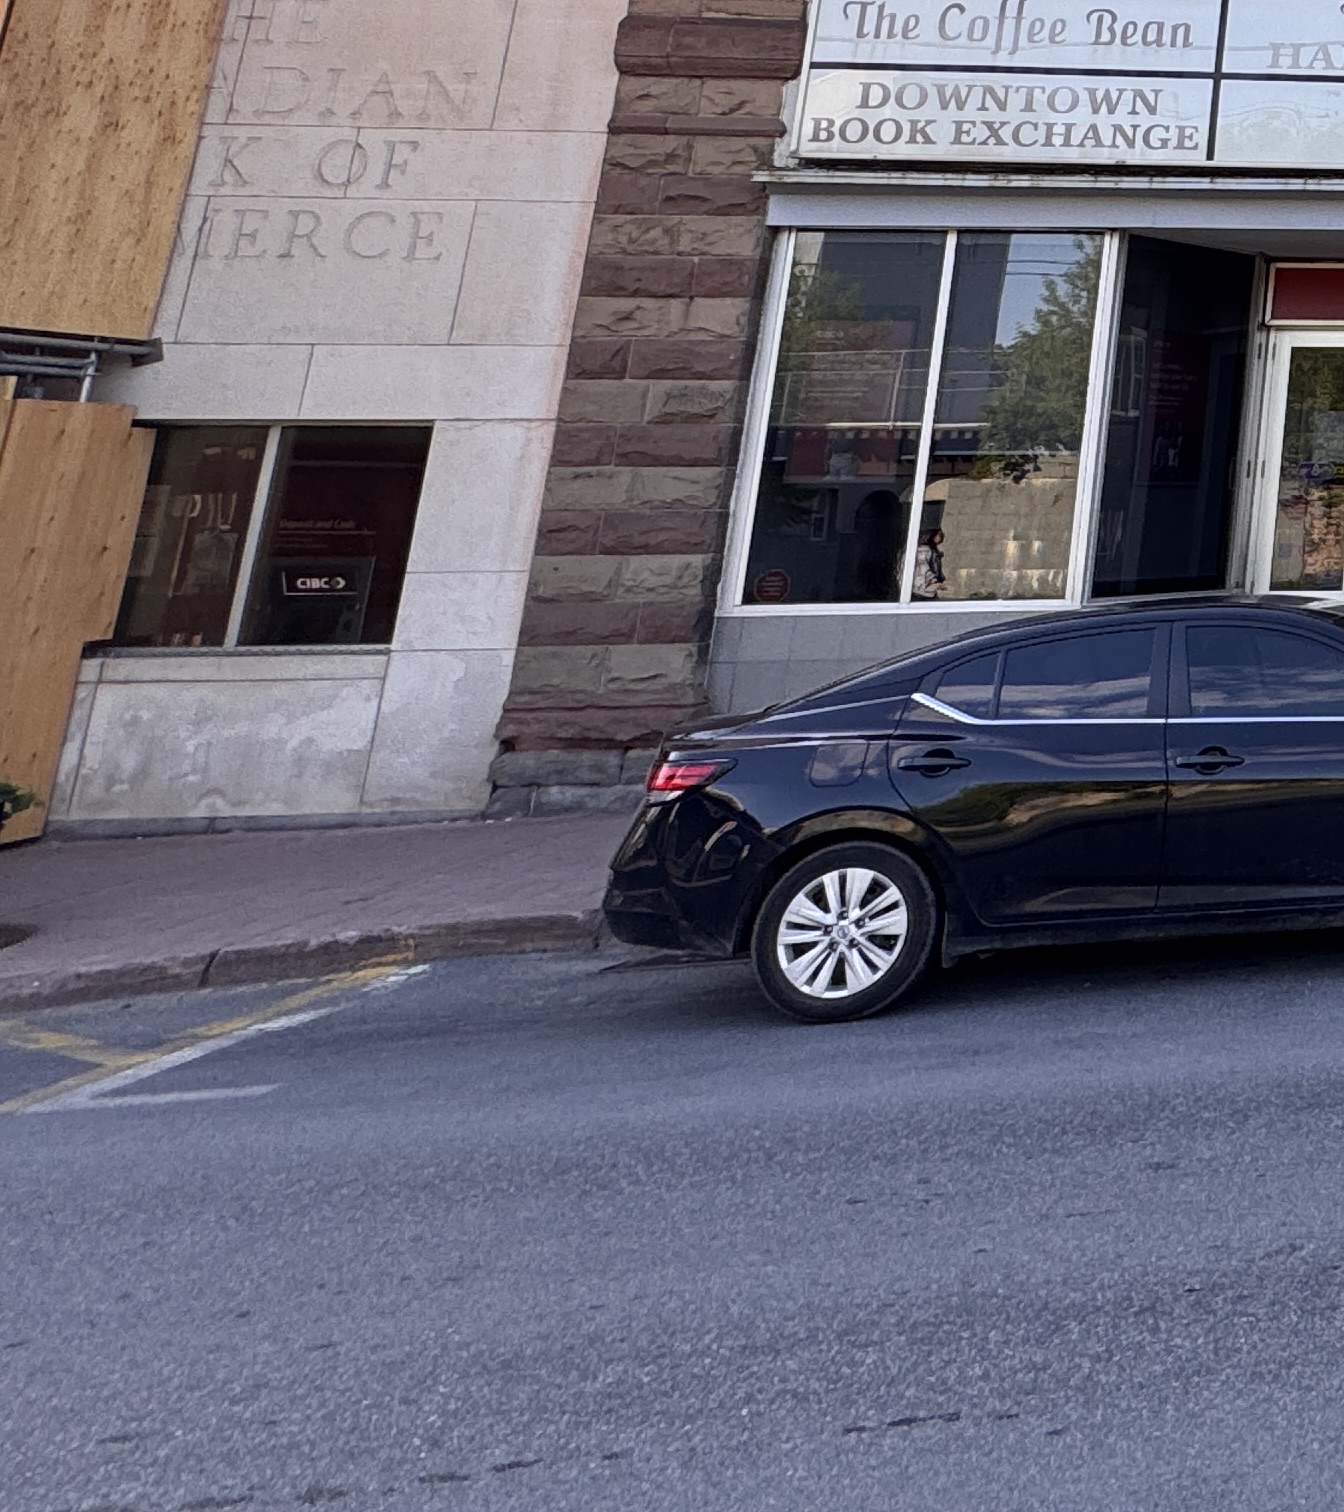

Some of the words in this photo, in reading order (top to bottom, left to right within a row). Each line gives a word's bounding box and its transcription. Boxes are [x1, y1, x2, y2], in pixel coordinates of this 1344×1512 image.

[842, 0, 921, 40] The
[1085, 8, 1195, 49] Bean
[854, 81, 1164, 117] DOWNTOWN
[808, 116, 938, 146] BOOK
[949, 119, 1200, 152] EXCHANGE
[312, 137, 421, 189] OF
[296, 577, 331, 589] CIBC
